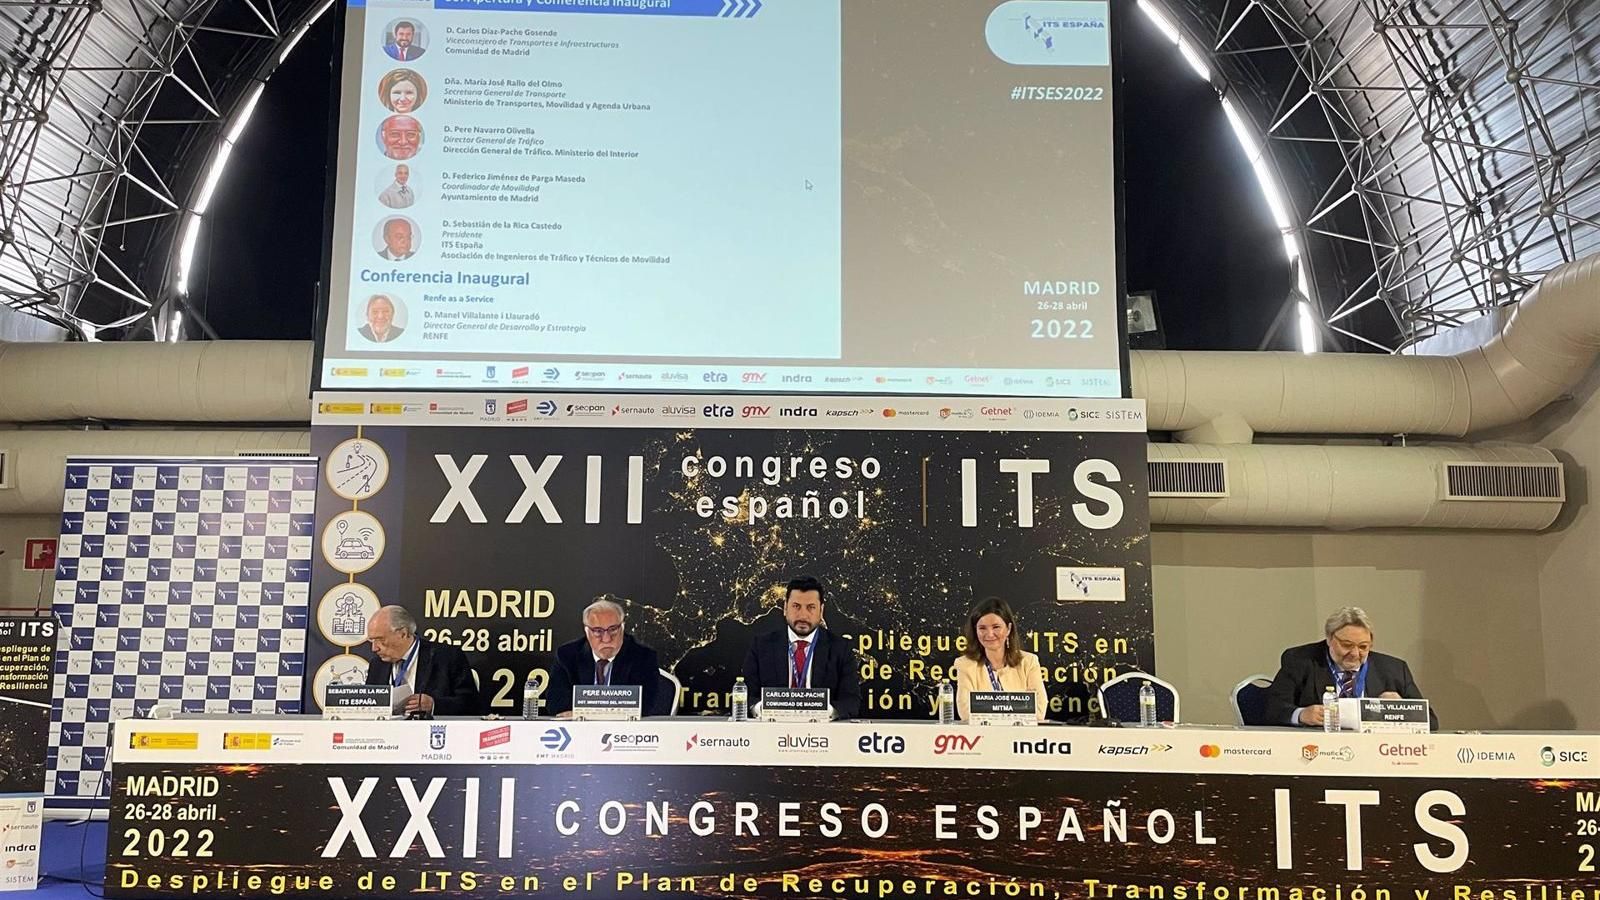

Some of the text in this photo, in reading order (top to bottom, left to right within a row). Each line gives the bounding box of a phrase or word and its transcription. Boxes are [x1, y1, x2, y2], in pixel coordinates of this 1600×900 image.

[525, 29, 557, 37] Gosende
[446, 37, 619, 48] Viceconsejero Transportes Infraestructuras
[445, 47, 488, 55] Comunidad
[443, 88, 566, 99] Secretaria General Transporte
[1011, 86, 1104, 101] #ITSES2022
[443, 98, 483, 106] Ministerio
[497, 100, 544, 109] Transportes,
[546, 101, 584, 109] Movilidad
[592, 102, 621, 110] Agenda
[506, 127, 535, 135] Olivella
[476, 136, 506, 144] General
[518, 138, 544, 146] Tráfico
[443, 146, 479, 154] Dirección
[555, 149, 594, 157] Ministerio
[531, 175, 553, 183] Parga
[501, 184, 540, 192] Movilidad
[441, 193, 497, 202] Ayuntamiento
[442, 231, 483, 239] Presidente
[455, 242, 483, 251] España
[441, 252, 483, 260] Asociación
[496, 253, 537, 262] Ingenieros
[551, 254, 578, 262] Tráfico
[586, 254, 618, 263] Técnicos
[632, 256, 670, 264] Movilidad
[361, 269, 529, 287] Conferencia Inaugural
[1024, 281, 1100, 295] MADRID
[1038, 301, 1088, 310] 26-28 abril
[423, 322, 455, 330] Director
[499, 324, 539, 332] Desarrollo
[547, 324, 586, 333] Estrategia
[1031, 319, 1094, 339] 2022
[703, 371, 812, 383] etra indra
[621, 406, 654, 414] sernauto
[662, 404, 696, 414] aluvisa
[703, 404, 734, 418] etra
[742, 405, 771, 418] gmv
[780, 406, 818, 416] indra
[826, 408, 858, 416] kapsch
[980, 406, 1012, 416] Getnet
[1106, 410, 1142, 420] SISTEM
[681, 451, 881, 485] congreso
[430, 454, 644, 524] XXII
[961, 458, 1124, 530] ITS
[696, 490, 866, 525] español
[424, 590, 555, 618] MADRID
[21, 622, 54, 637] ITS
[498, 629, 552, 652] abril
[1033, 631, 1128, 655] ITS en
[861, 660, 893, 681] de
[614, 732, 1588, 762] seopan sernauto aluvisa etra gmv indra kapsch mastercard Getnet IDEMIA SICE
[126, 776, 219, 797] MADRID
[125, 803, 217, 821] 26-28 abril
[320, 777, 1470, 873] XXII CONGRESO ESPAÑOL ITS
[5, 844, 36, 852] indra
[122, 828, 214, 857] 2022
[6, 876, 33, 884] SISTEM
[120, 870, 1390, 900] Despliegue de ITS en el Plan de Recuperación, Transformación
